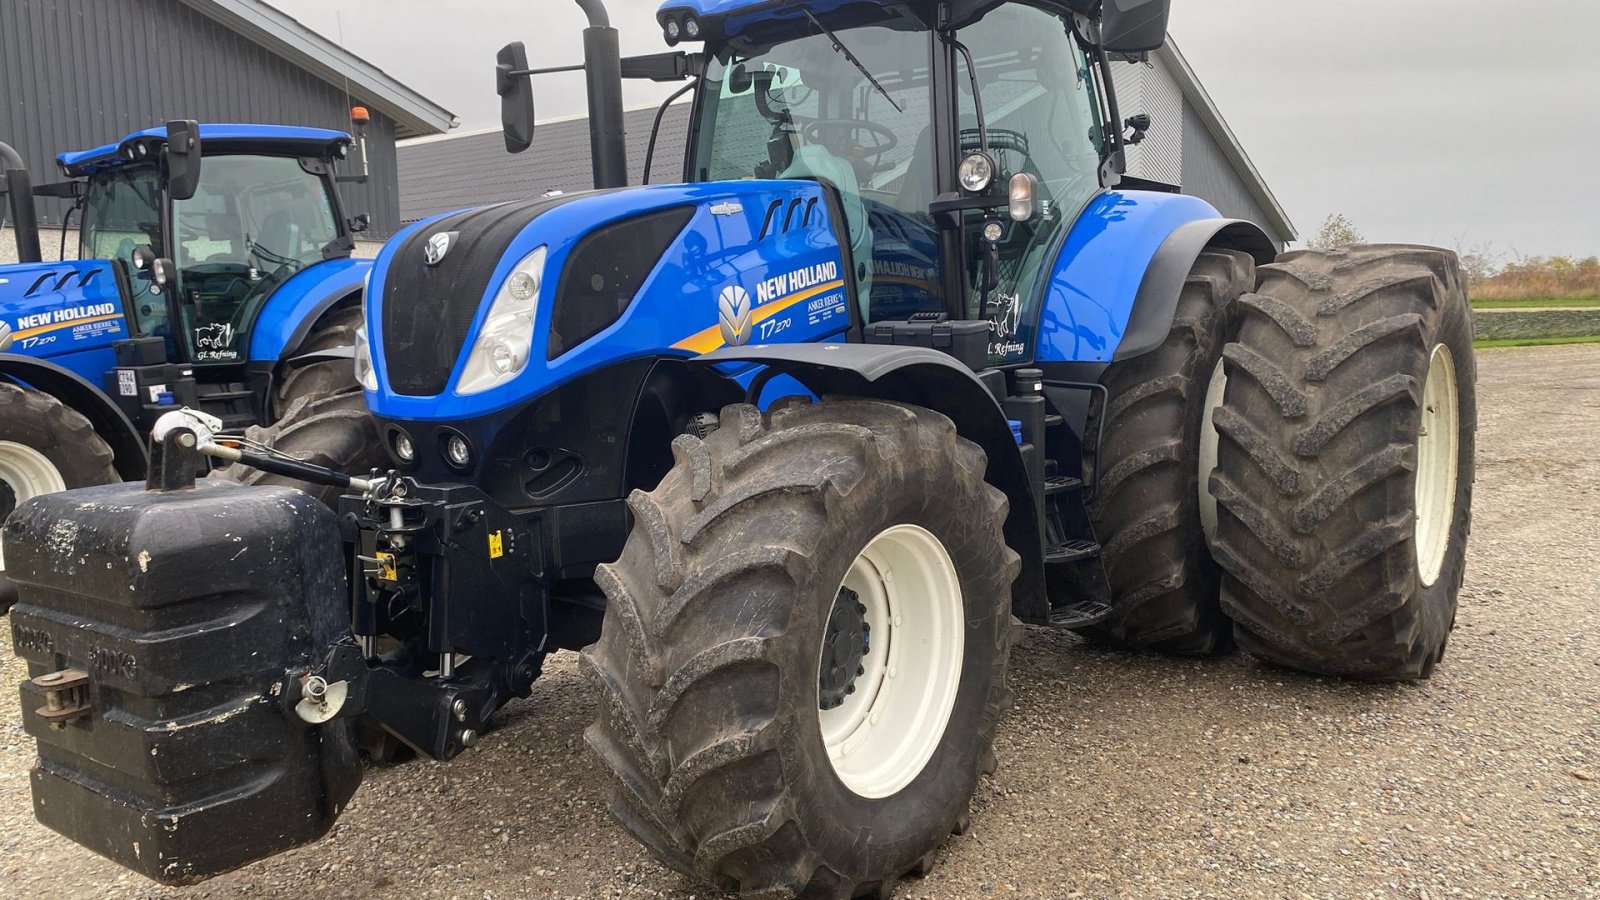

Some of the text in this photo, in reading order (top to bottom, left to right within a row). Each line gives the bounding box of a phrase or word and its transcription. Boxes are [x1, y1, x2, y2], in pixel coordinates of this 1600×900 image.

[757, 261, 837, 304] NEW HOLLAND
[808, 298, 825, 312] ANKER
[18, 303, 115, 330] NEW HOLLAND
[72, 324, 93, 334] ANKER
[209, 350, 237, 360] Refning
[994, 340, 1024, 357] Refning
